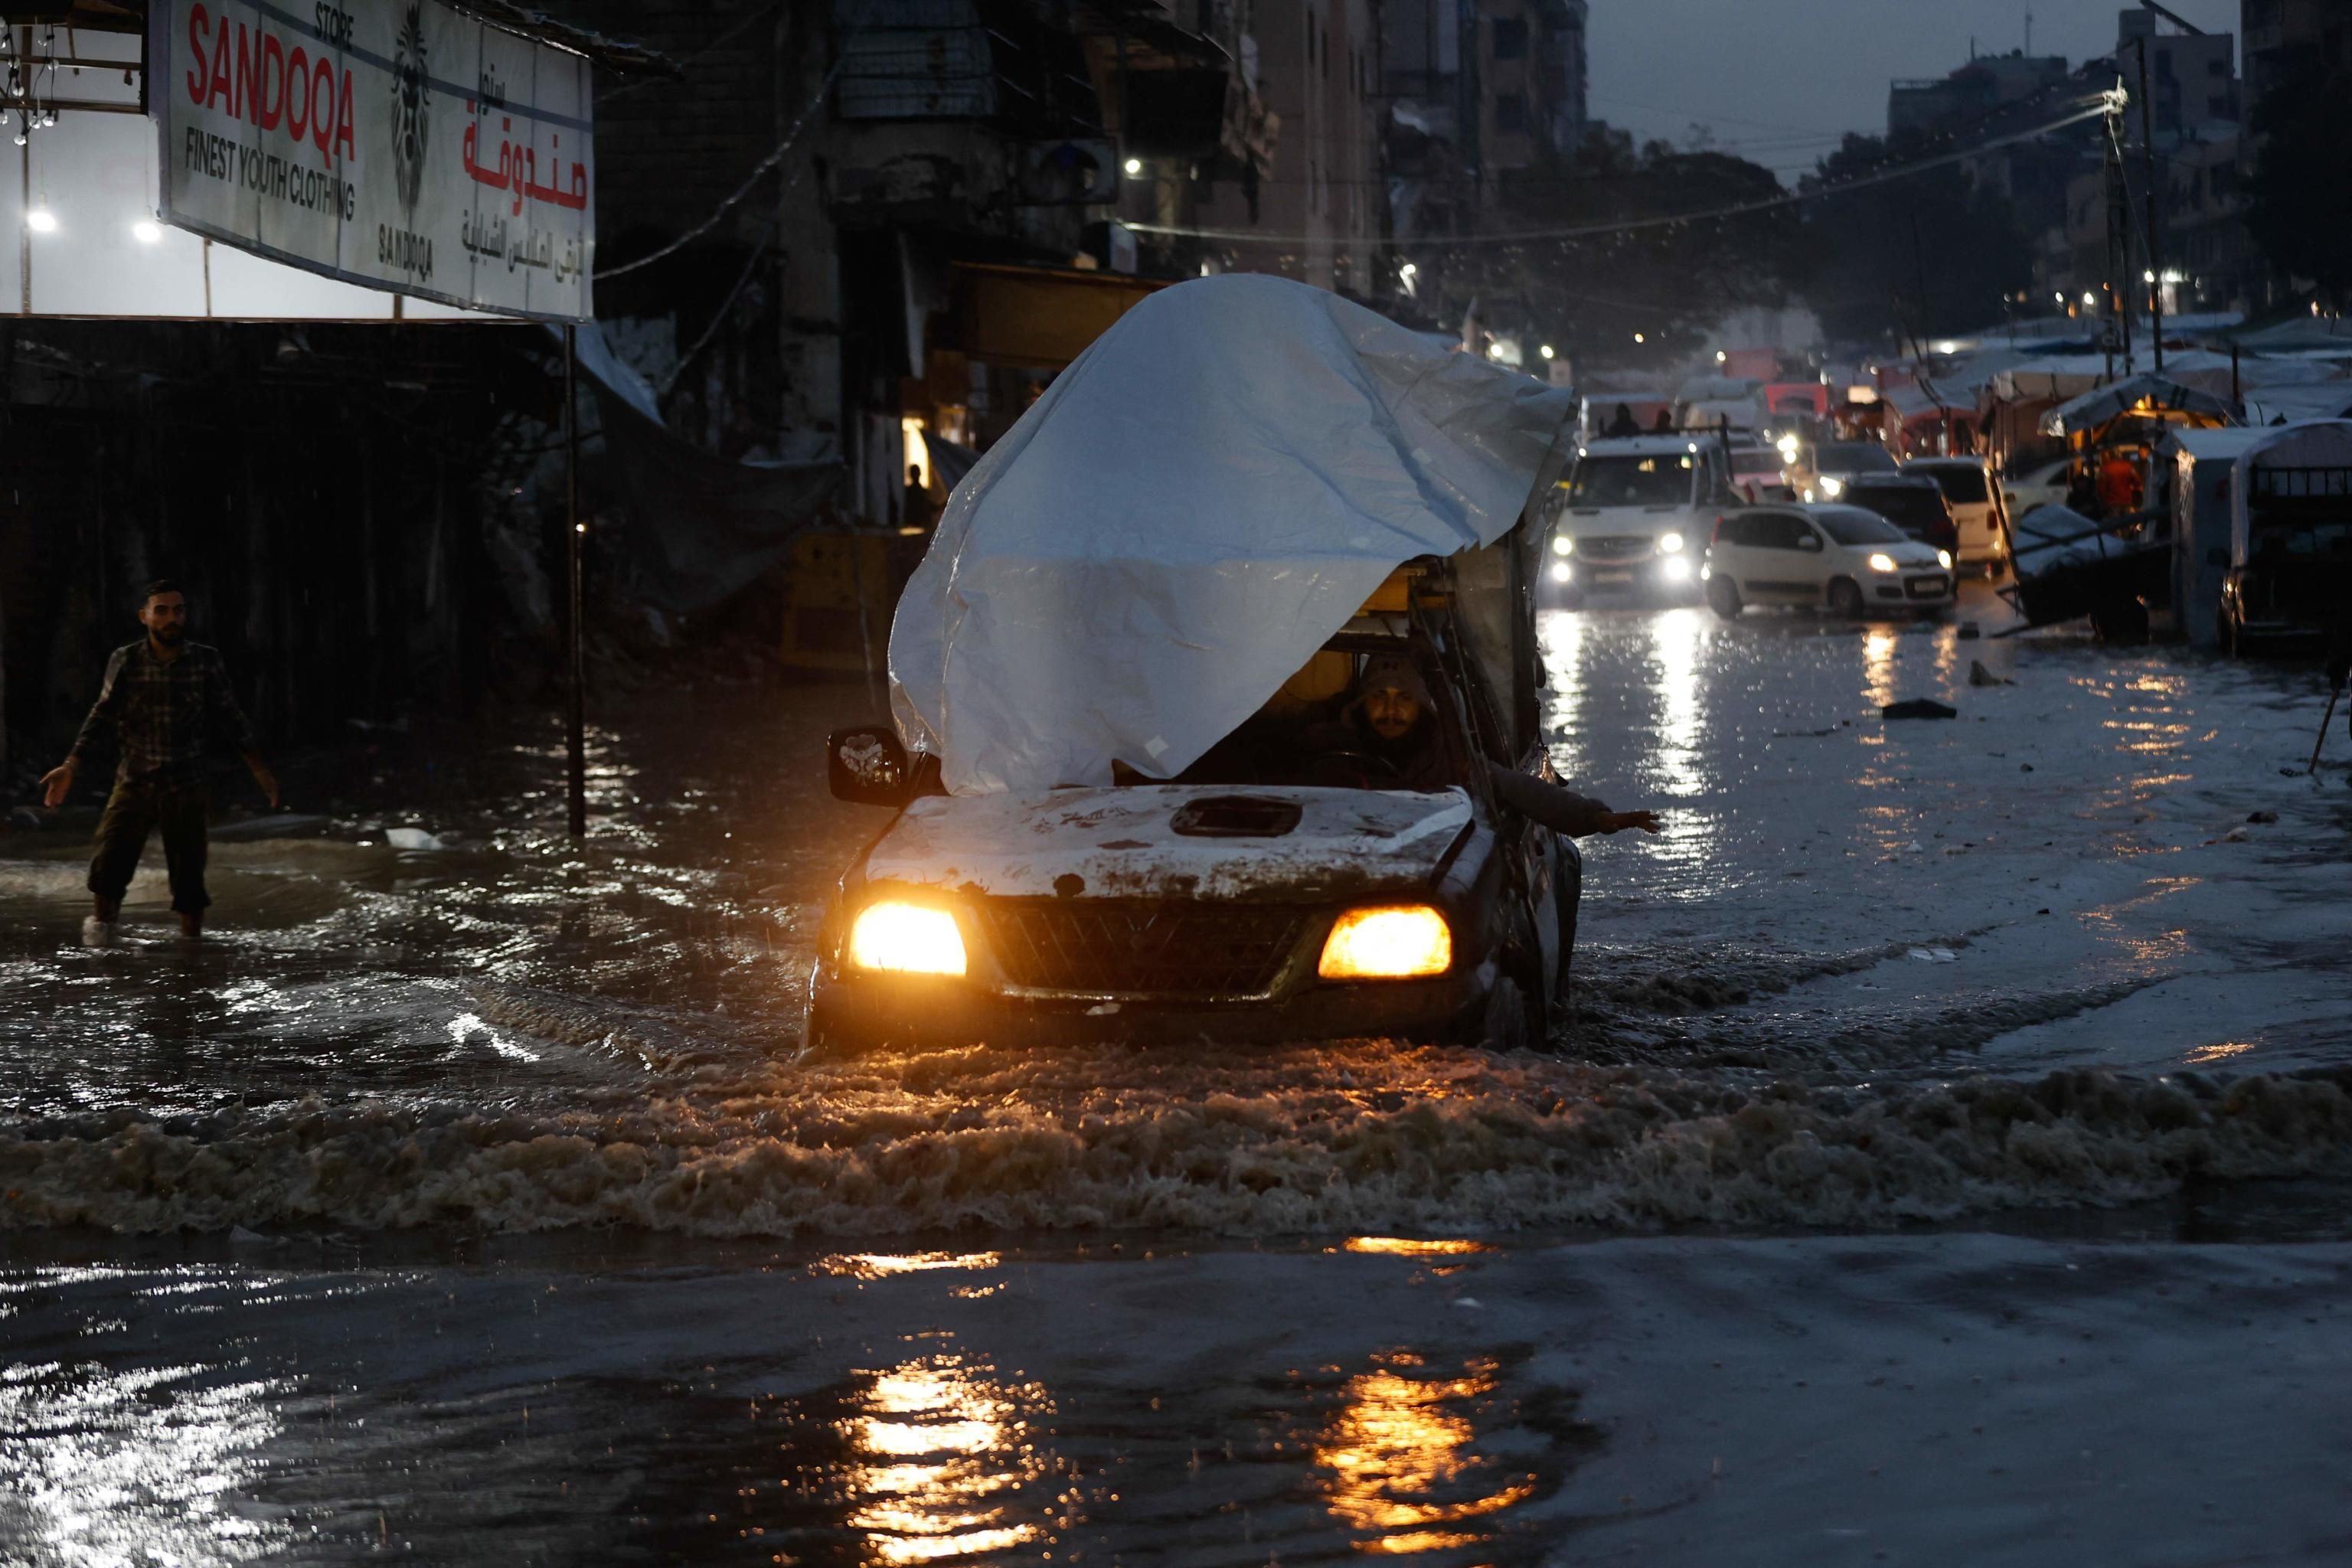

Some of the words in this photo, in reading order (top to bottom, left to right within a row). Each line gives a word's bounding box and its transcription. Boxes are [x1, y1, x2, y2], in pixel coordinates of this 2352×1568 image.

[315, 1, 354, 52] STORE
[187, 2, 354, 170] SANDOQA
[185, 126, 236, 183] FINEST
[239, 144, 287, 200] YOUTH
[290, 163, 355, 221] CLOTHING
[463, 97, 587, 217] صندوقة
[379, 223, 433, 283] SANDOQA
